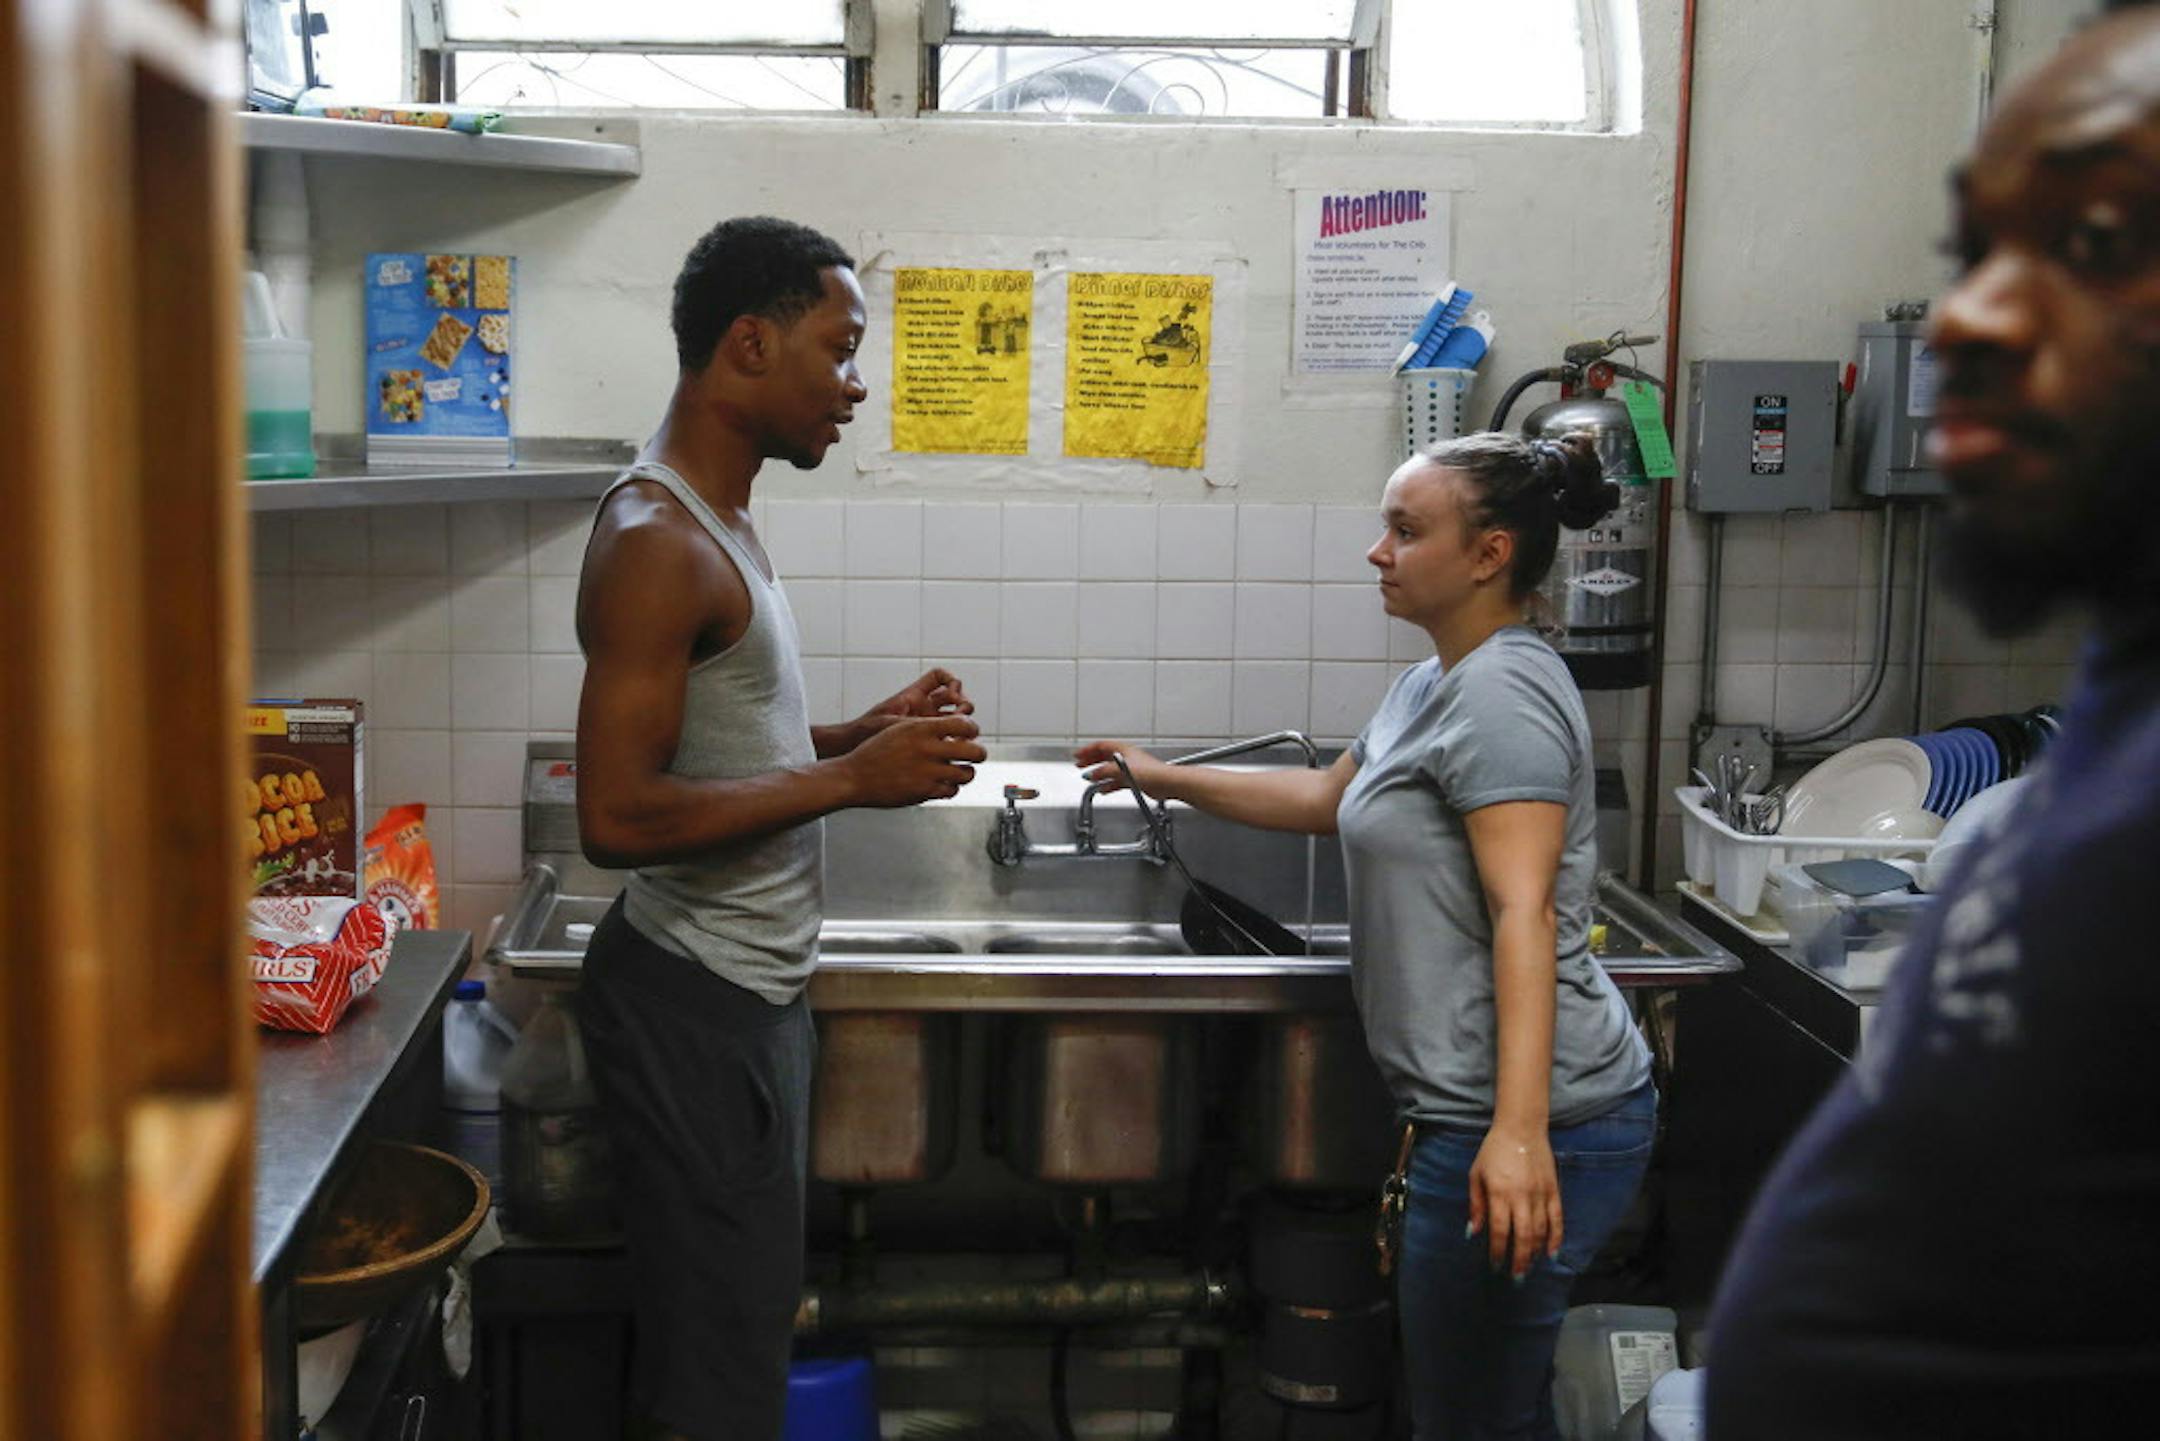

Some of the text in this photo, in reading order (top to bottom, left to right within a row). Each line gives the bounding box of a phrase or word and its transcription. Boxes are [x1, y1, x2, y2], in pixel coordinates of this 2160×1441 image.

[1320, 189, 1427, 238] Attention:
[1379, 240, 1390, 249] for
[1393, 240, 1407, 249] The
[1075, 278, 1211, 299] Dinner Dishes
[1761, 396, 1782, 408] ON
[1755, 463, 1780, 474] OFF
